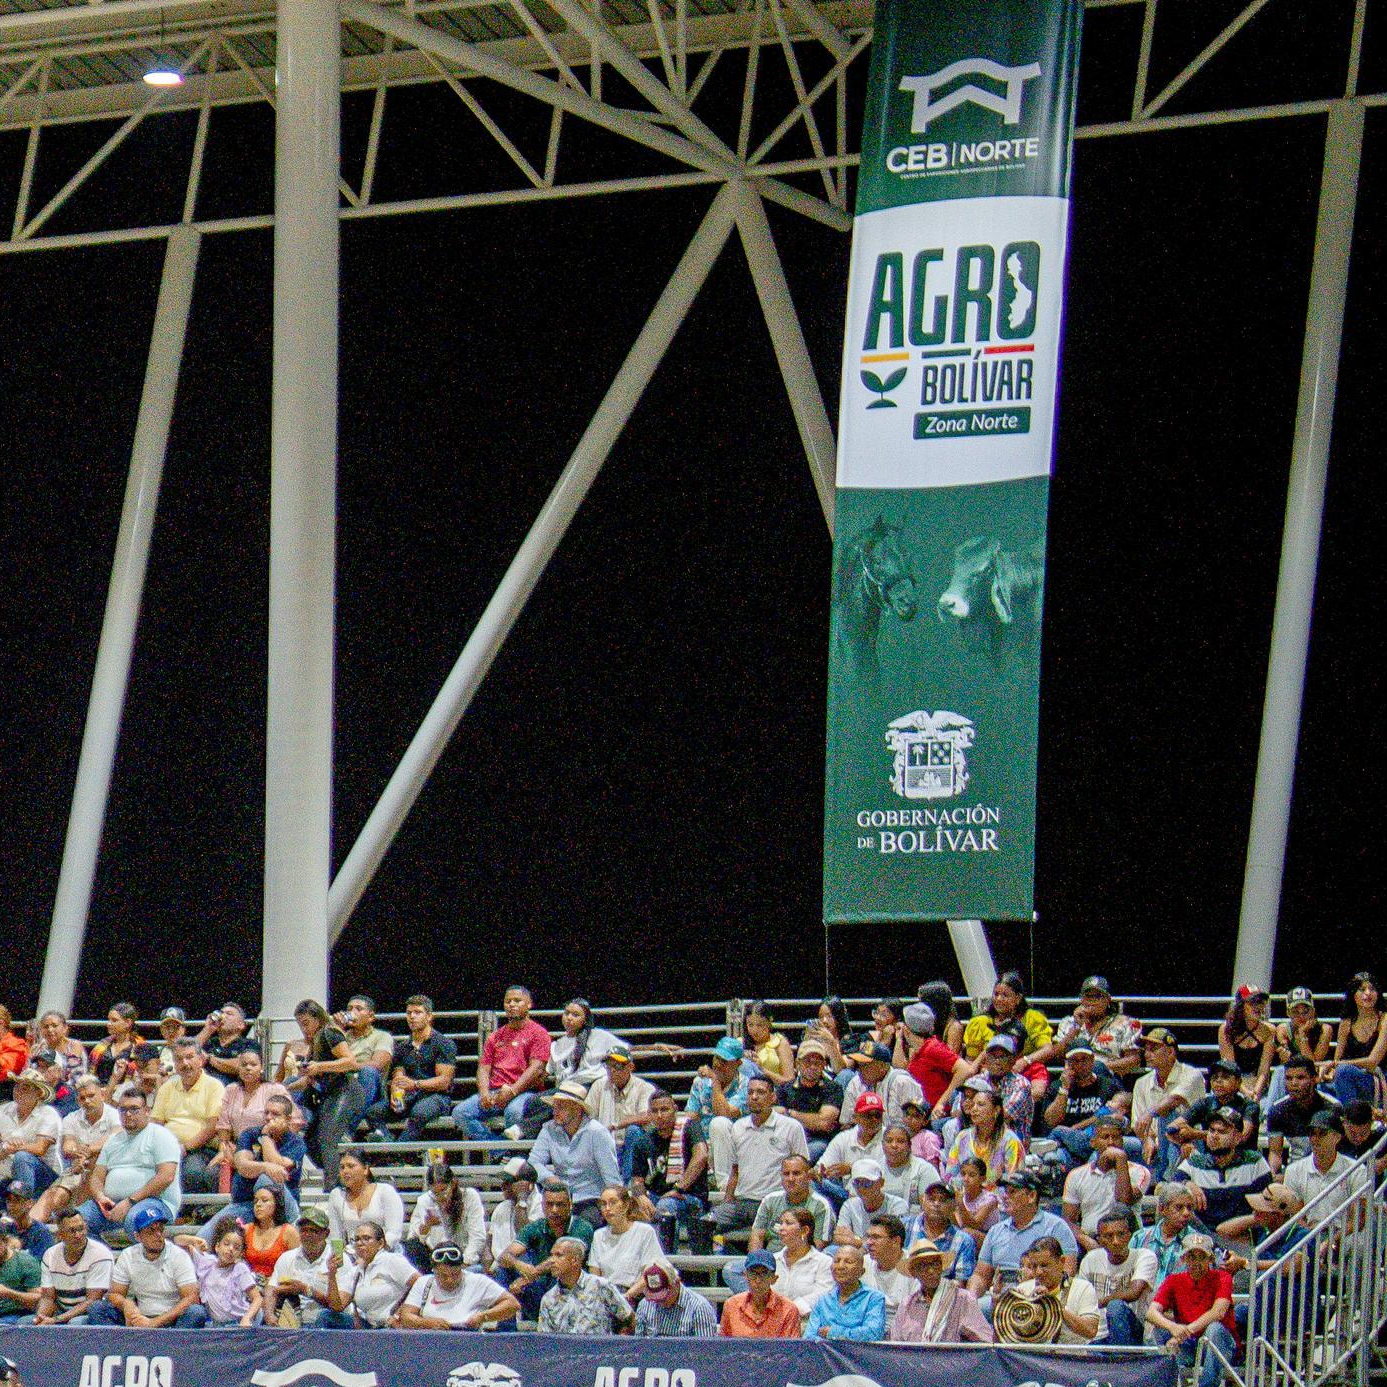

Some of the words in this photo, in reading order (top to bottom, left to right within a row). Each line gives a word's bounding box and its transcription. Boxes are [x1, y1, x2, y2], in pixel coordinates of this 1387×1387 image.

[886, 144, 948, 173] CEB
[960, 138, 1040, 164] NORTE
[862, 240, 1040, 350] AGRO
[921, 349, 1033, 406] BOLÍVAR
[925, 416, 966, 433] Zona
[971, 414, 1018, 430] Norte
[857, 803, 999, 827] GOBERNACIÓN
[857, 837, 874, 849] DE
[879, 826, 1000, 853] BOLÍVAR
